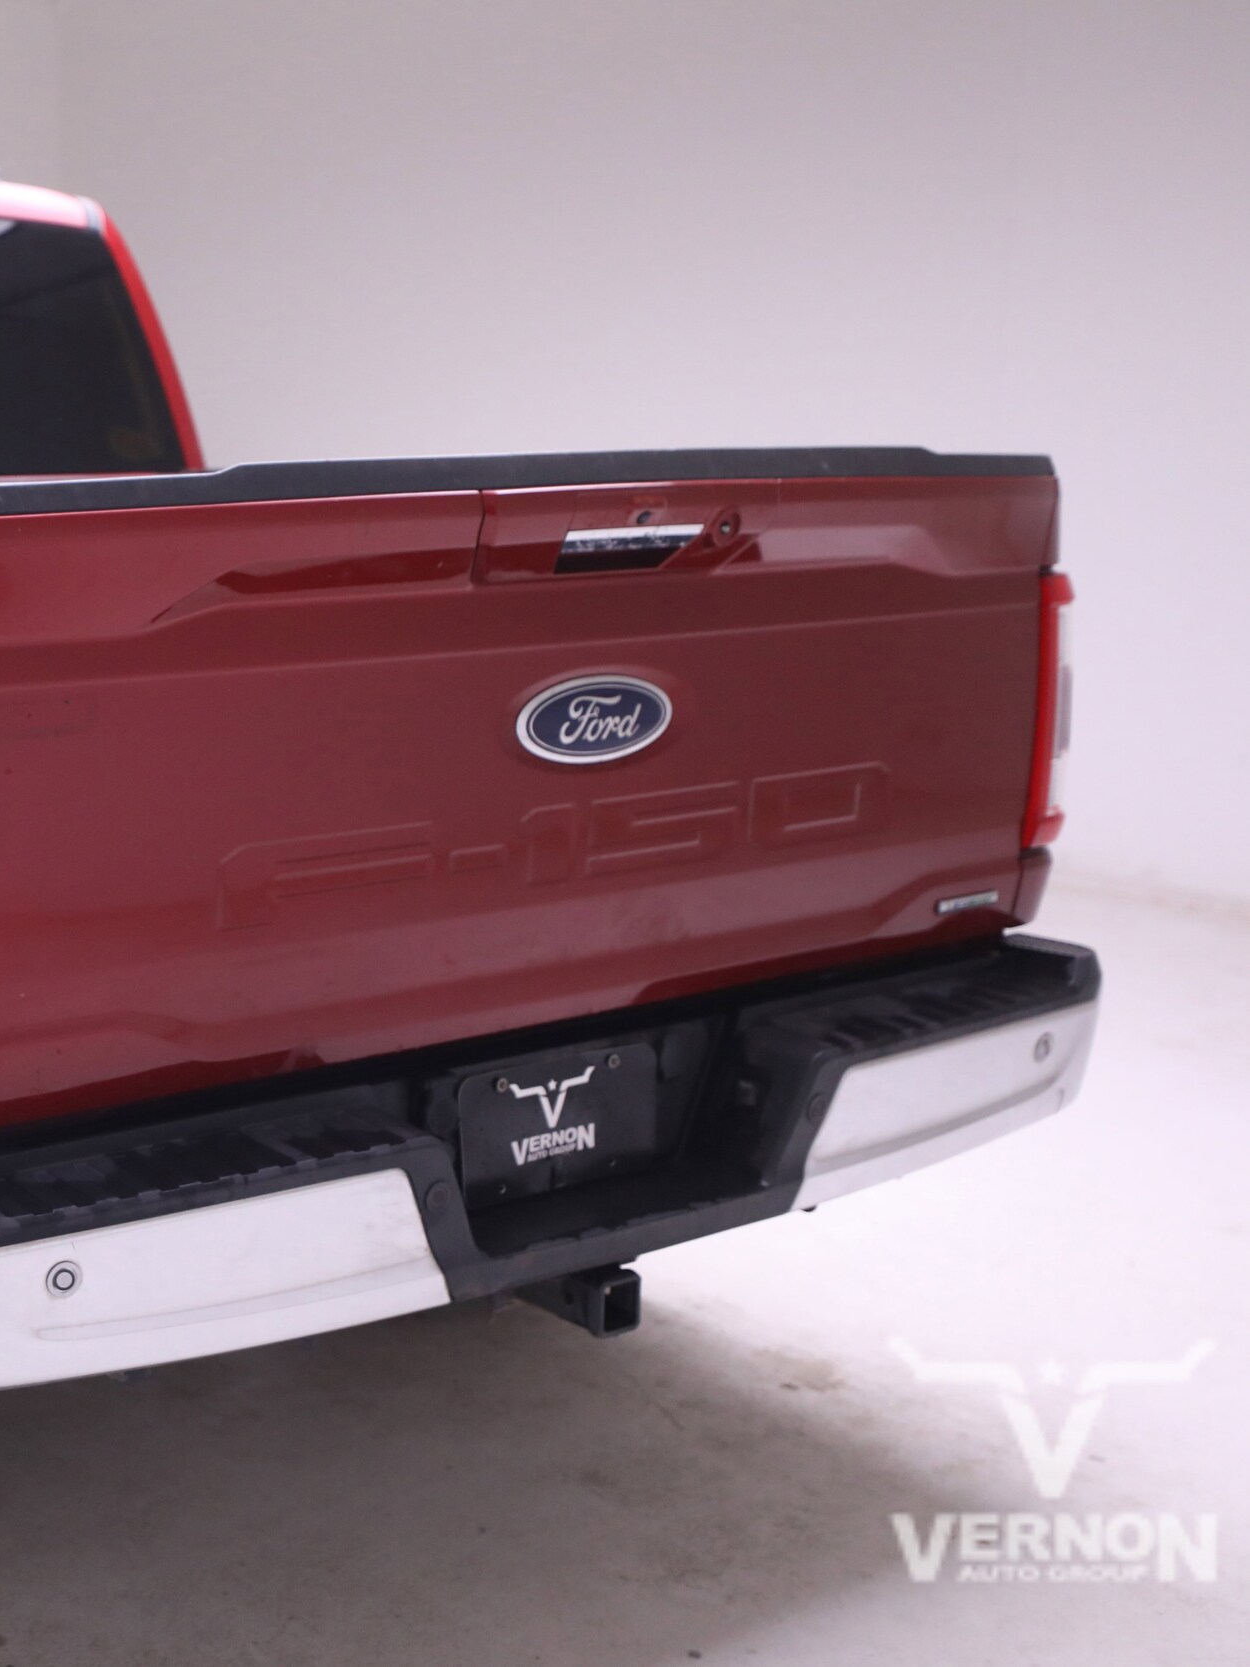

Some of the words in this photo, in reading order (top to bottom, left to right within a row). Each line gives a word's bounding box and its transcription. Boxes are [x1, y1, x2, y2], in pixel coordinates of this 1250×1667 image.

[559, 694, 643, 745] Ford
[215, 760, 893, 932] F-150
[511, 1123, 596, 1166] VERNON
